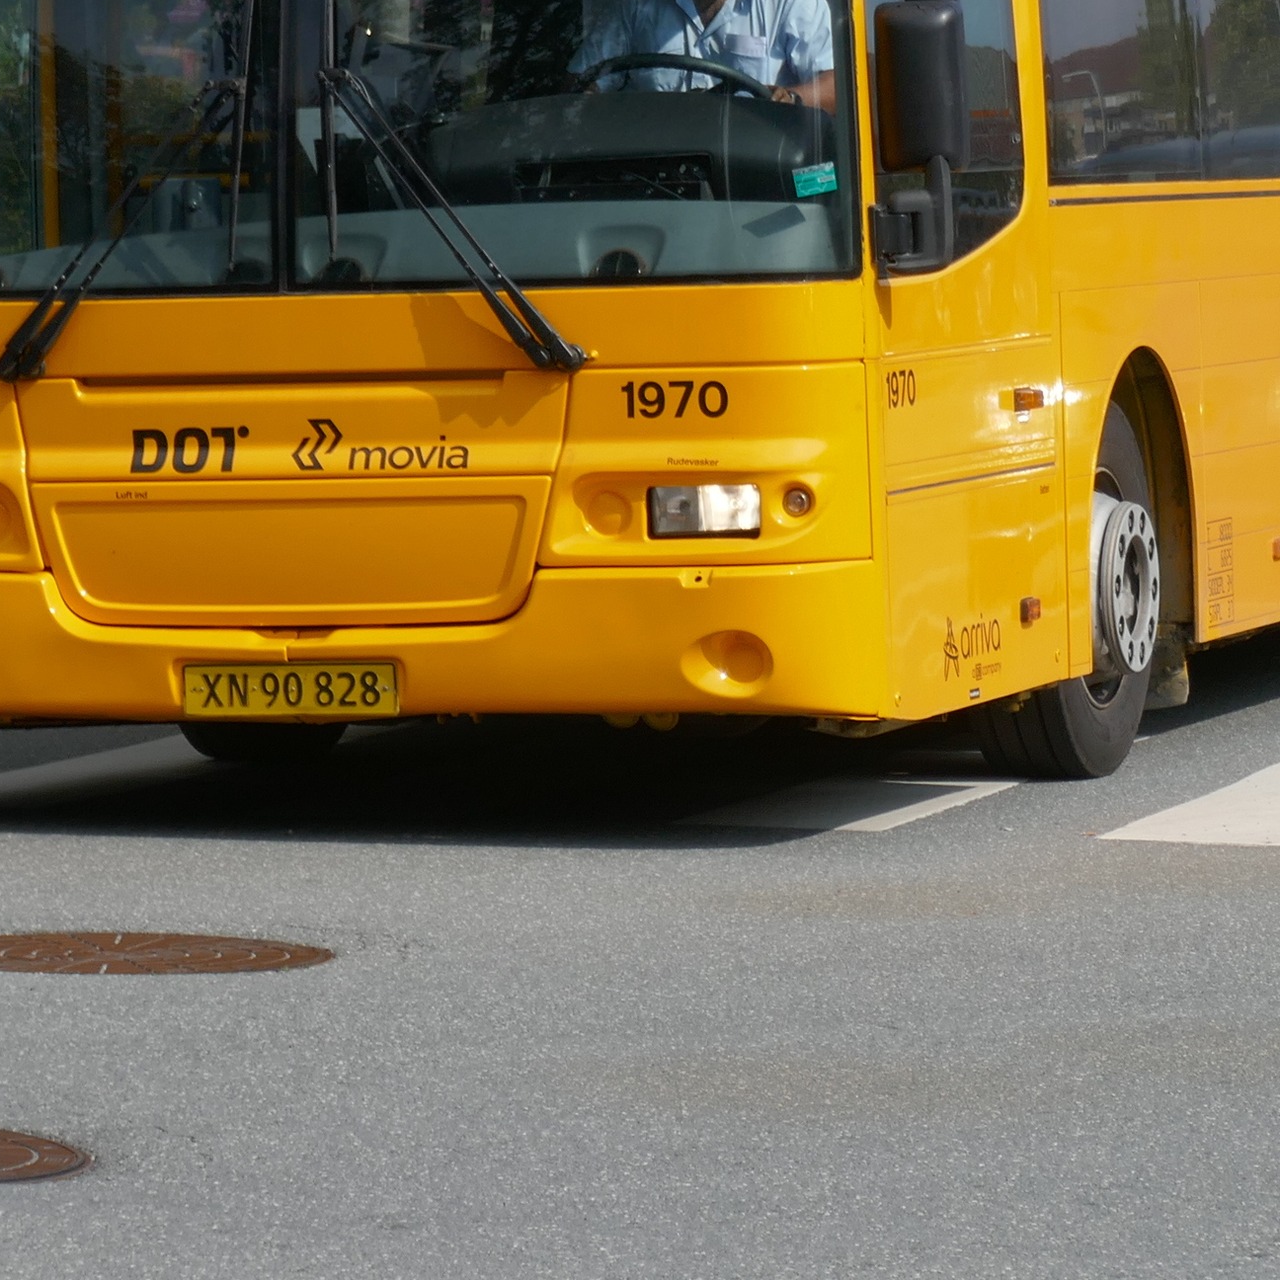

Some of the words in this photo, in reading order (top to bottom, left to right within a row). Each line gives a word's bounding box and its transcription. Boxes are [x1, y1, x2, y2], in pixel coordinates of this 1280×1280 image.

[621, 380, 729, 418] 1970
[886, 369, 916, 409] 1970
[130, 426, 238, 474] DOT
[348, 434, 469, 470] movia
[960, 612, 1001, 660] arriva
[202, 673, 249, 707] XN
[261, 671, 303, 707] 90
[315, 670, 381, 707] 828
